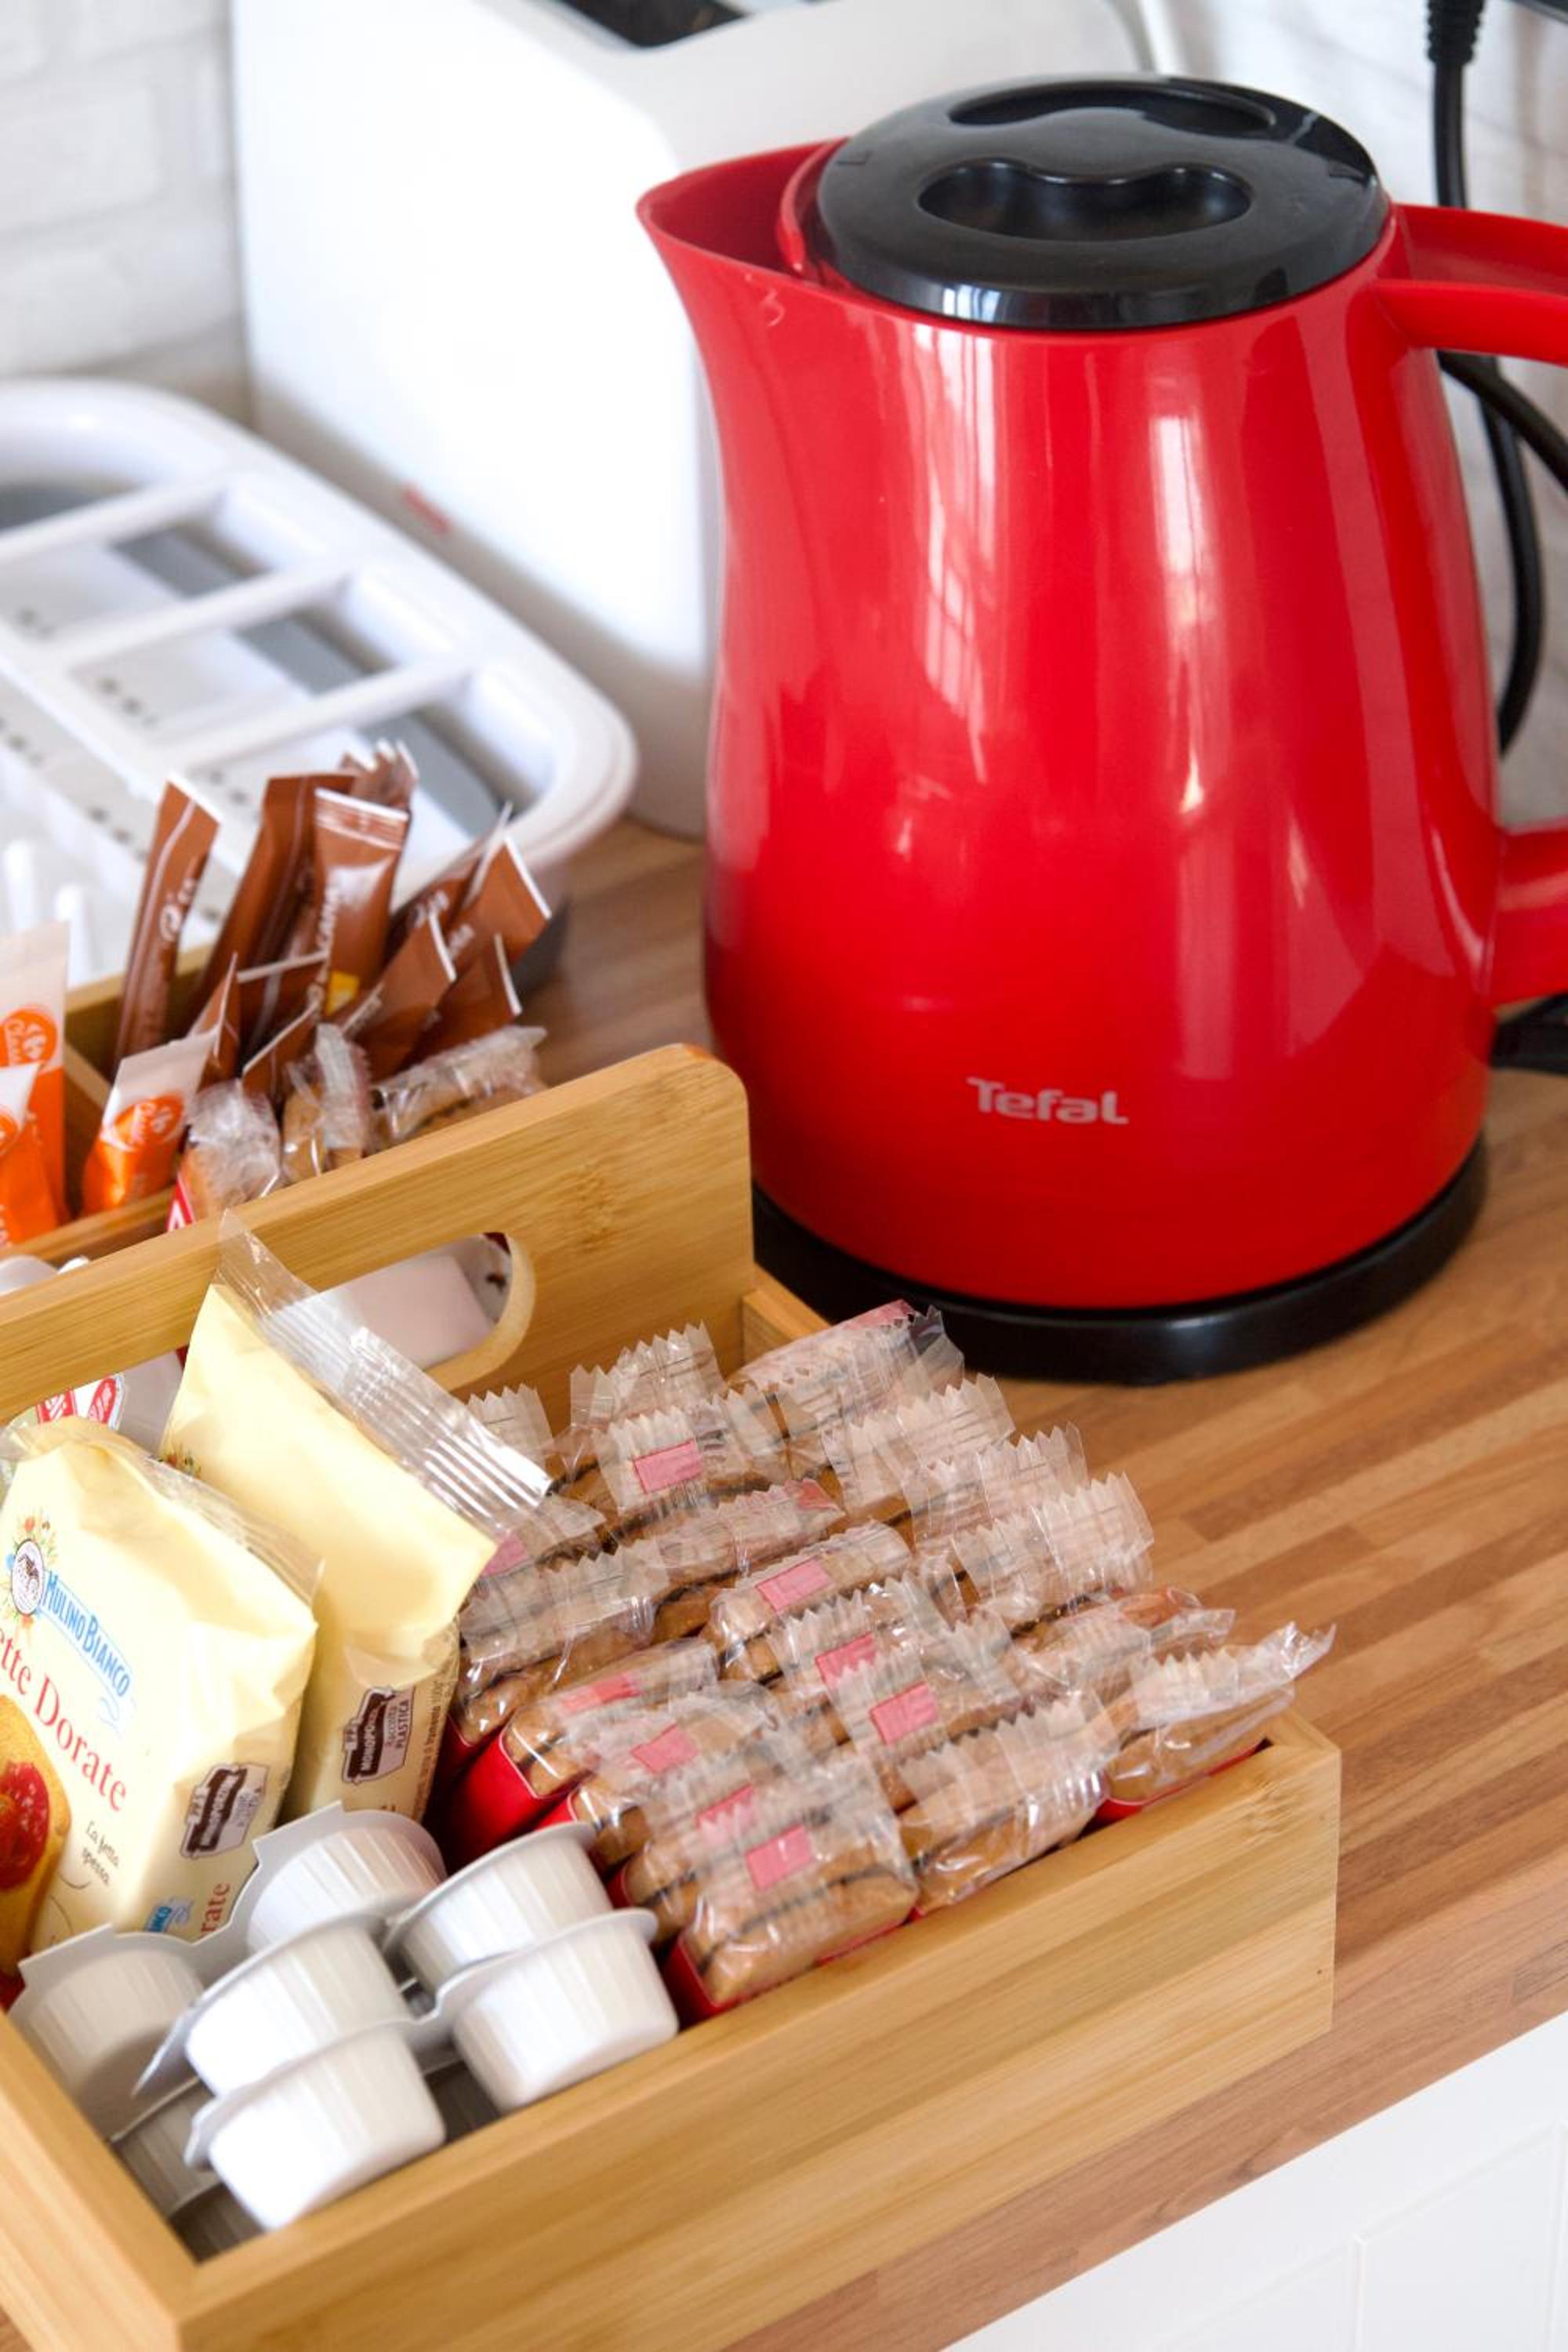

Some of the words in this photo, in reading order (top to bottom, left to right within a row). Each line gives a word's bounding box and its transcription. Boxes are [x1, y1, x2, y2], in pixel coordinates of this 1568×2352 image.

[966, 1076, 1129, 1124] Tefal
[43, 1570, 86, 1641] MULINO
[82, 1614, 131, 1697] BIANCO
[0, 1628, 31, 1695] tte
[34, 1673, 126, 1812] Dorate
[395, 1700, 409, 1749] PLASTICA
